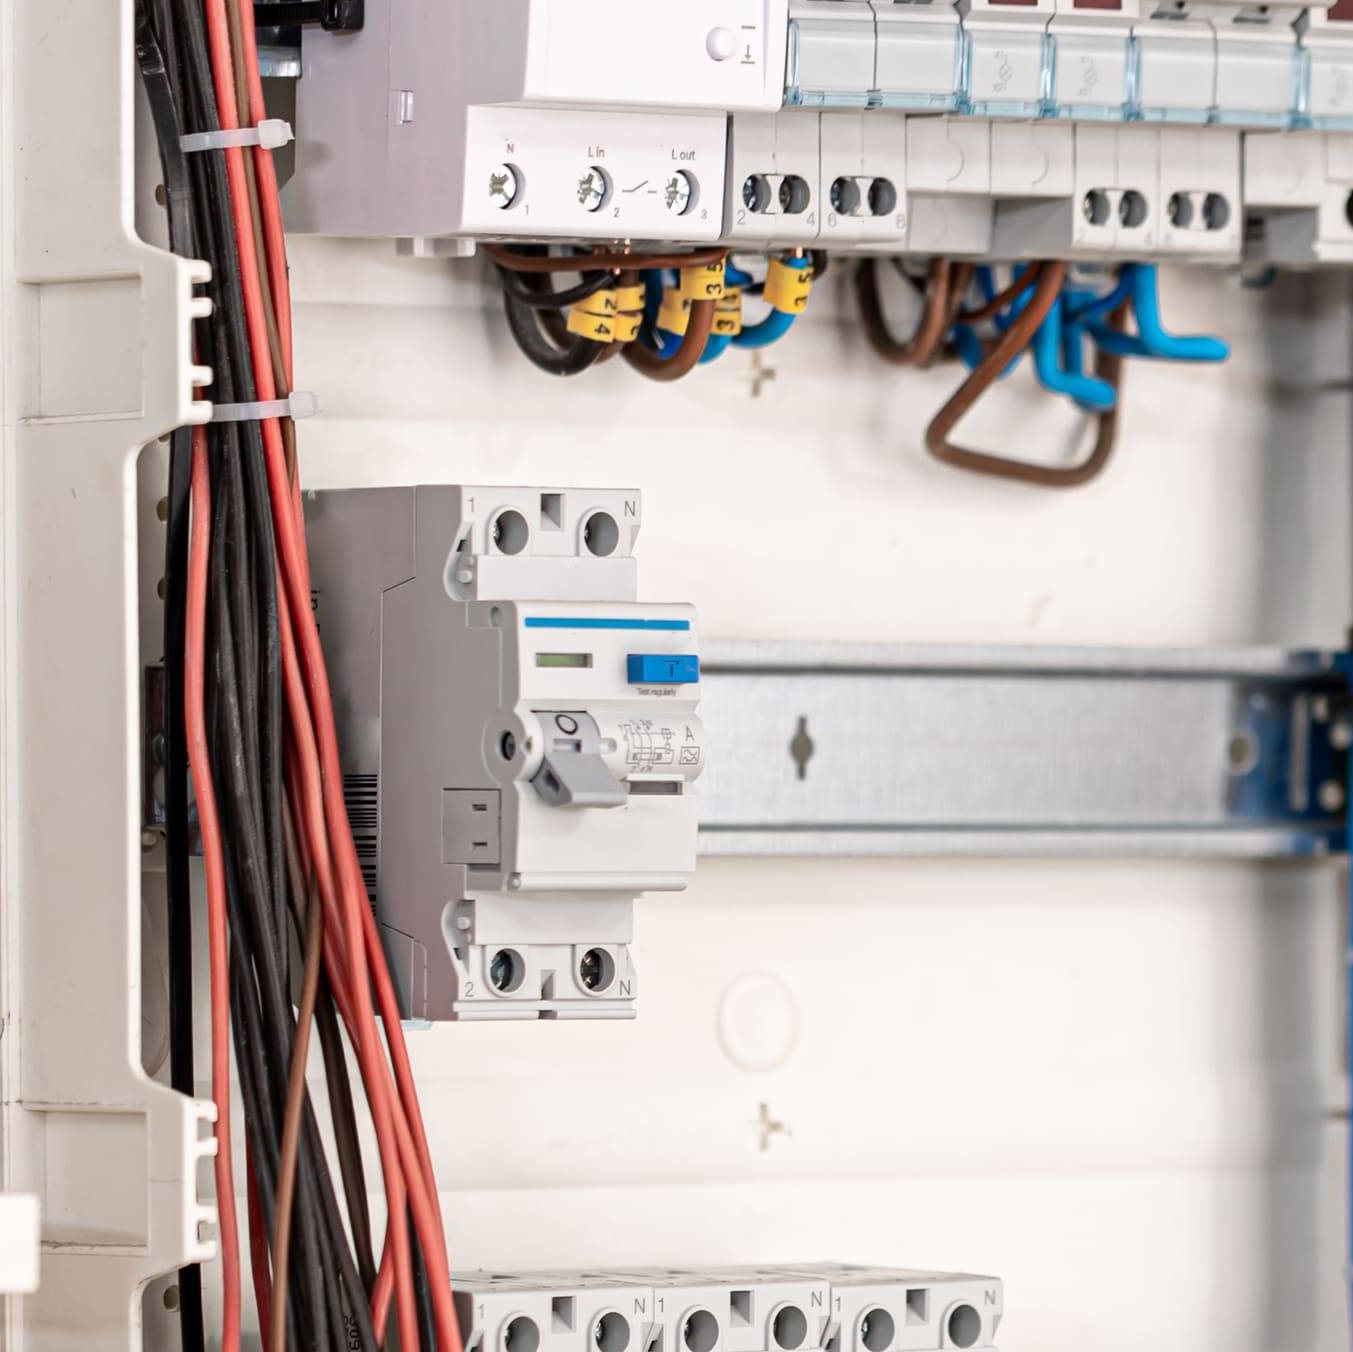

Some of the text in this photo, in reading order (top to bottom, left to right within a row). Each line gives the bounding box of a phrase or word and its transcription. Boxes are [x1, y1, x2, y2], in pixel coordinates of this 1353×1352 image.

[506, 143, 515, 154] N
[737, 210, 746, 225] 2
[806, 211, 816, 227] 4
[828, 213, 837, 228] 6
[624, 500, 636, 517] N
[664, 660, 680, 677] T
[685, 726, 695, 742] A
[464, 981, 474, 998] 2
[620, 979, 631, 996] N
[811, 1291, 822, 1308] N
[984, 1290, 996, 1306] N
[634, 1298, 646, 1315] N
